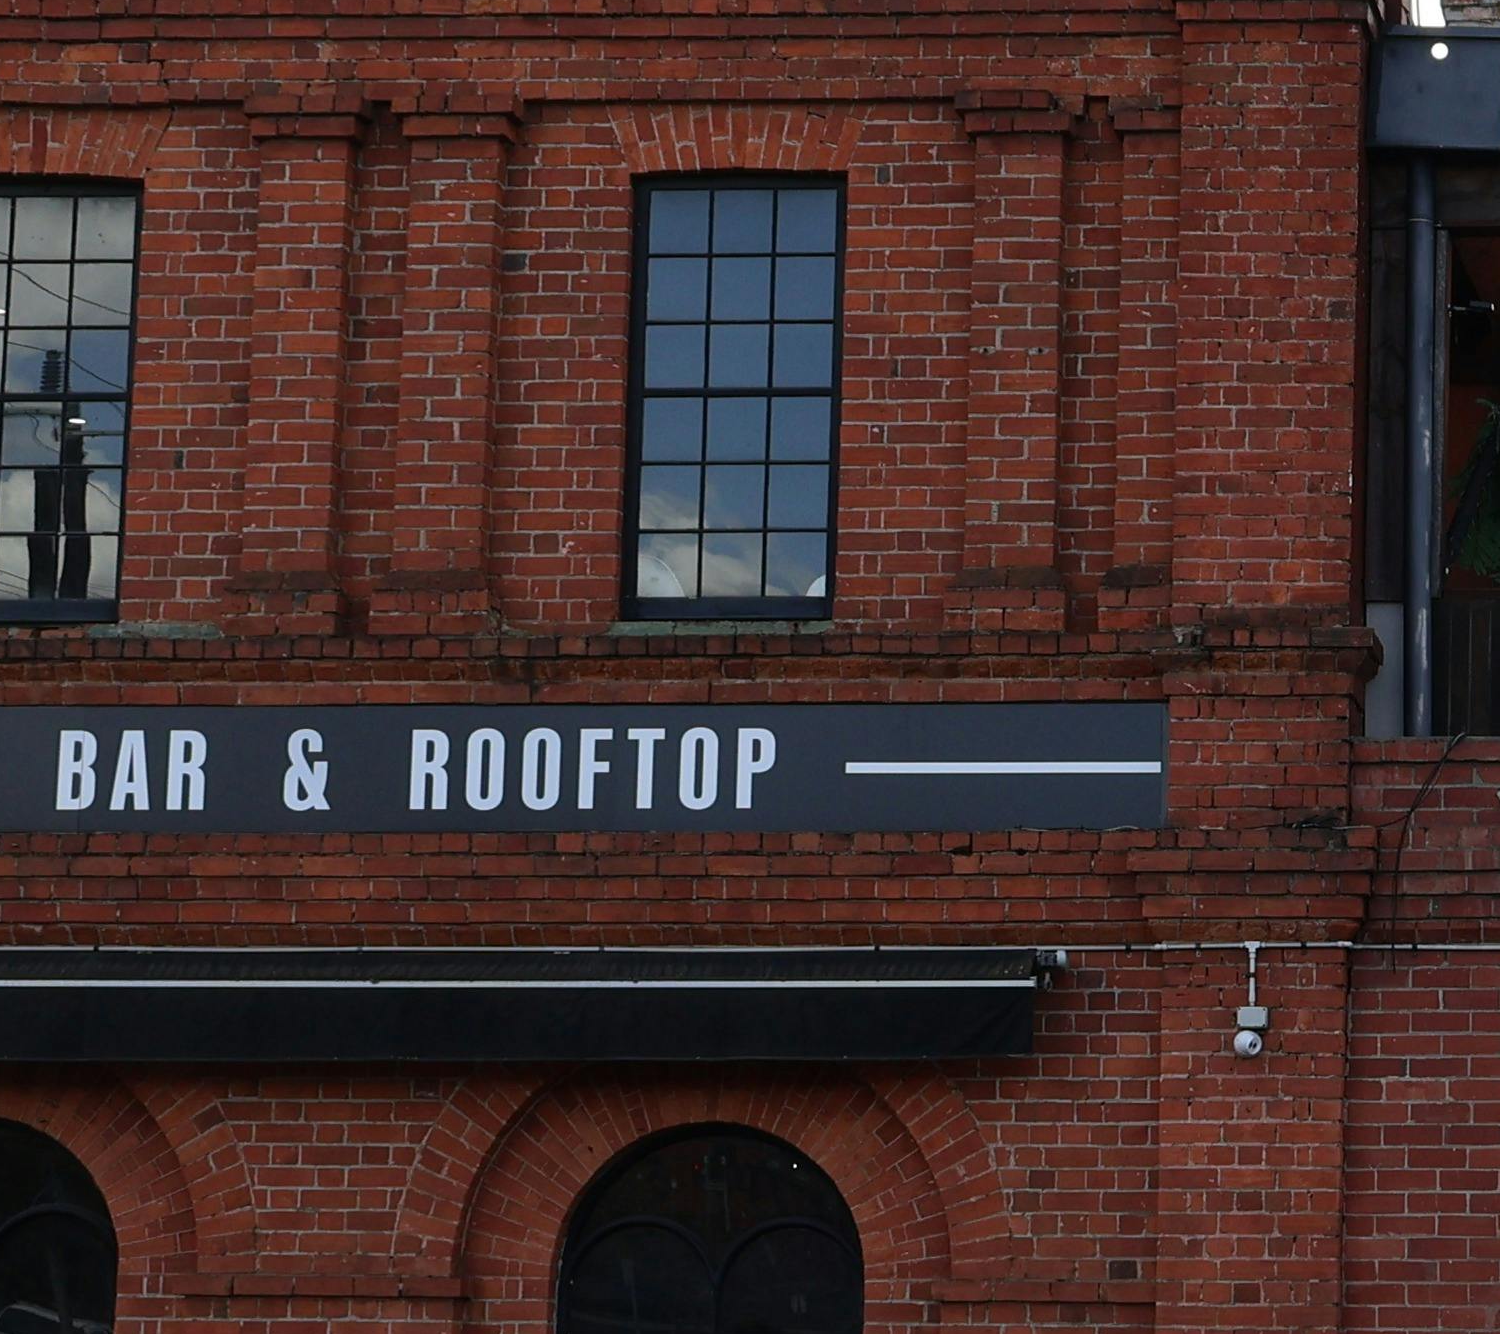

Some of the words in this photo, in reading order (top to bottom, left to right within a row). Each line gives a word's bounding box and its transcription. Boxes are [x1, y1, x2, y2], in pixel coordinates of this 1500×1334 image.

[56, 729, 207, 812] BAR
[282, 728, 331, 812] &
[408, 727, 777, 811] ROOFTOP
